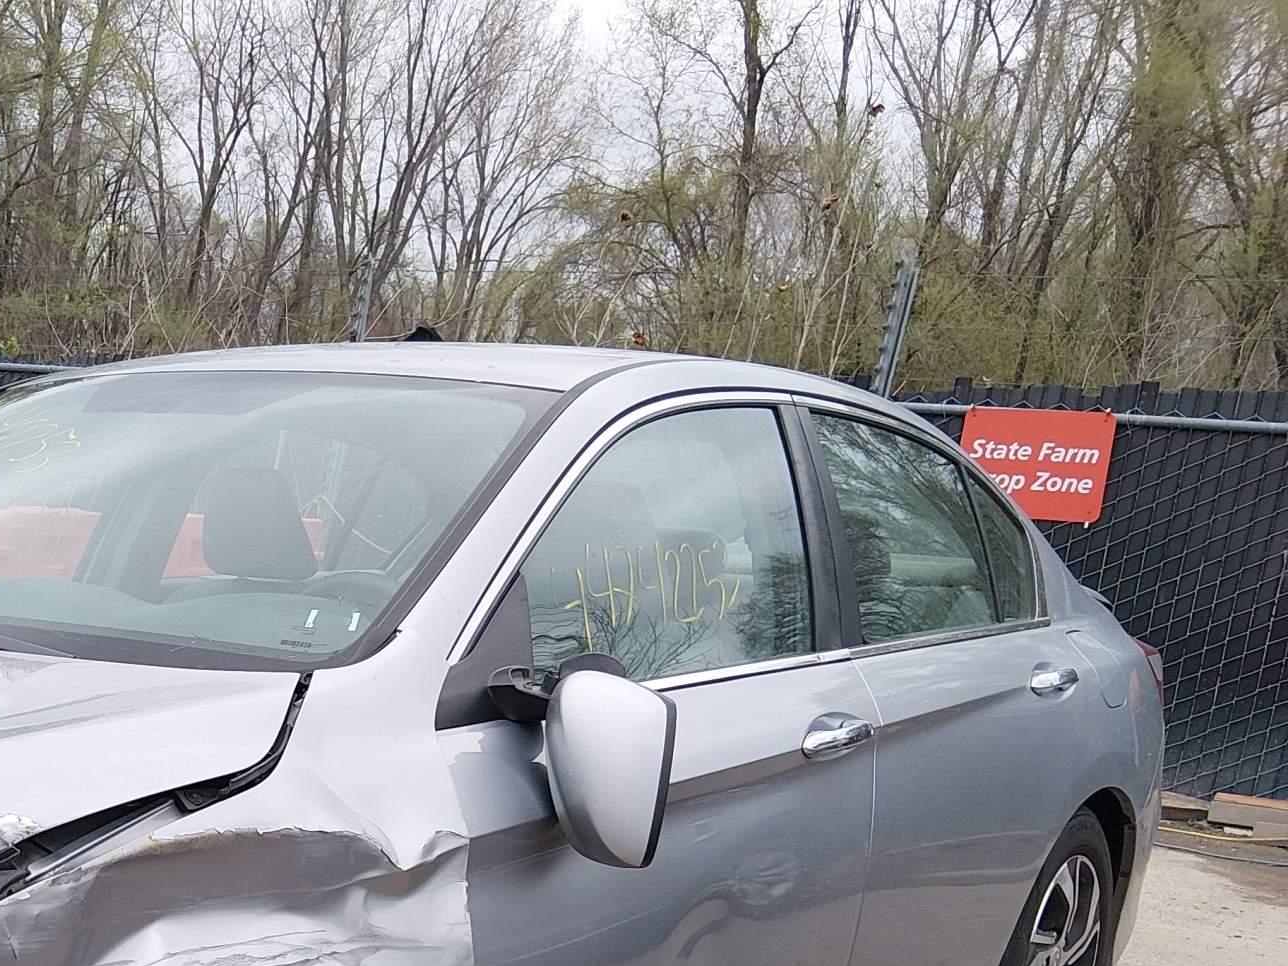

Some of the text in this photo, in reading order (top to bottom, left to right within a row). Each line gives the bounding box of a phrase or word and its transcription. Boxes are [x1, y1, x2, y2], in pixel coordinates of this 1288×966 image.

[969, 439, 1099, 464] State Farm
[1030, 472, 1093, 494] Zone
